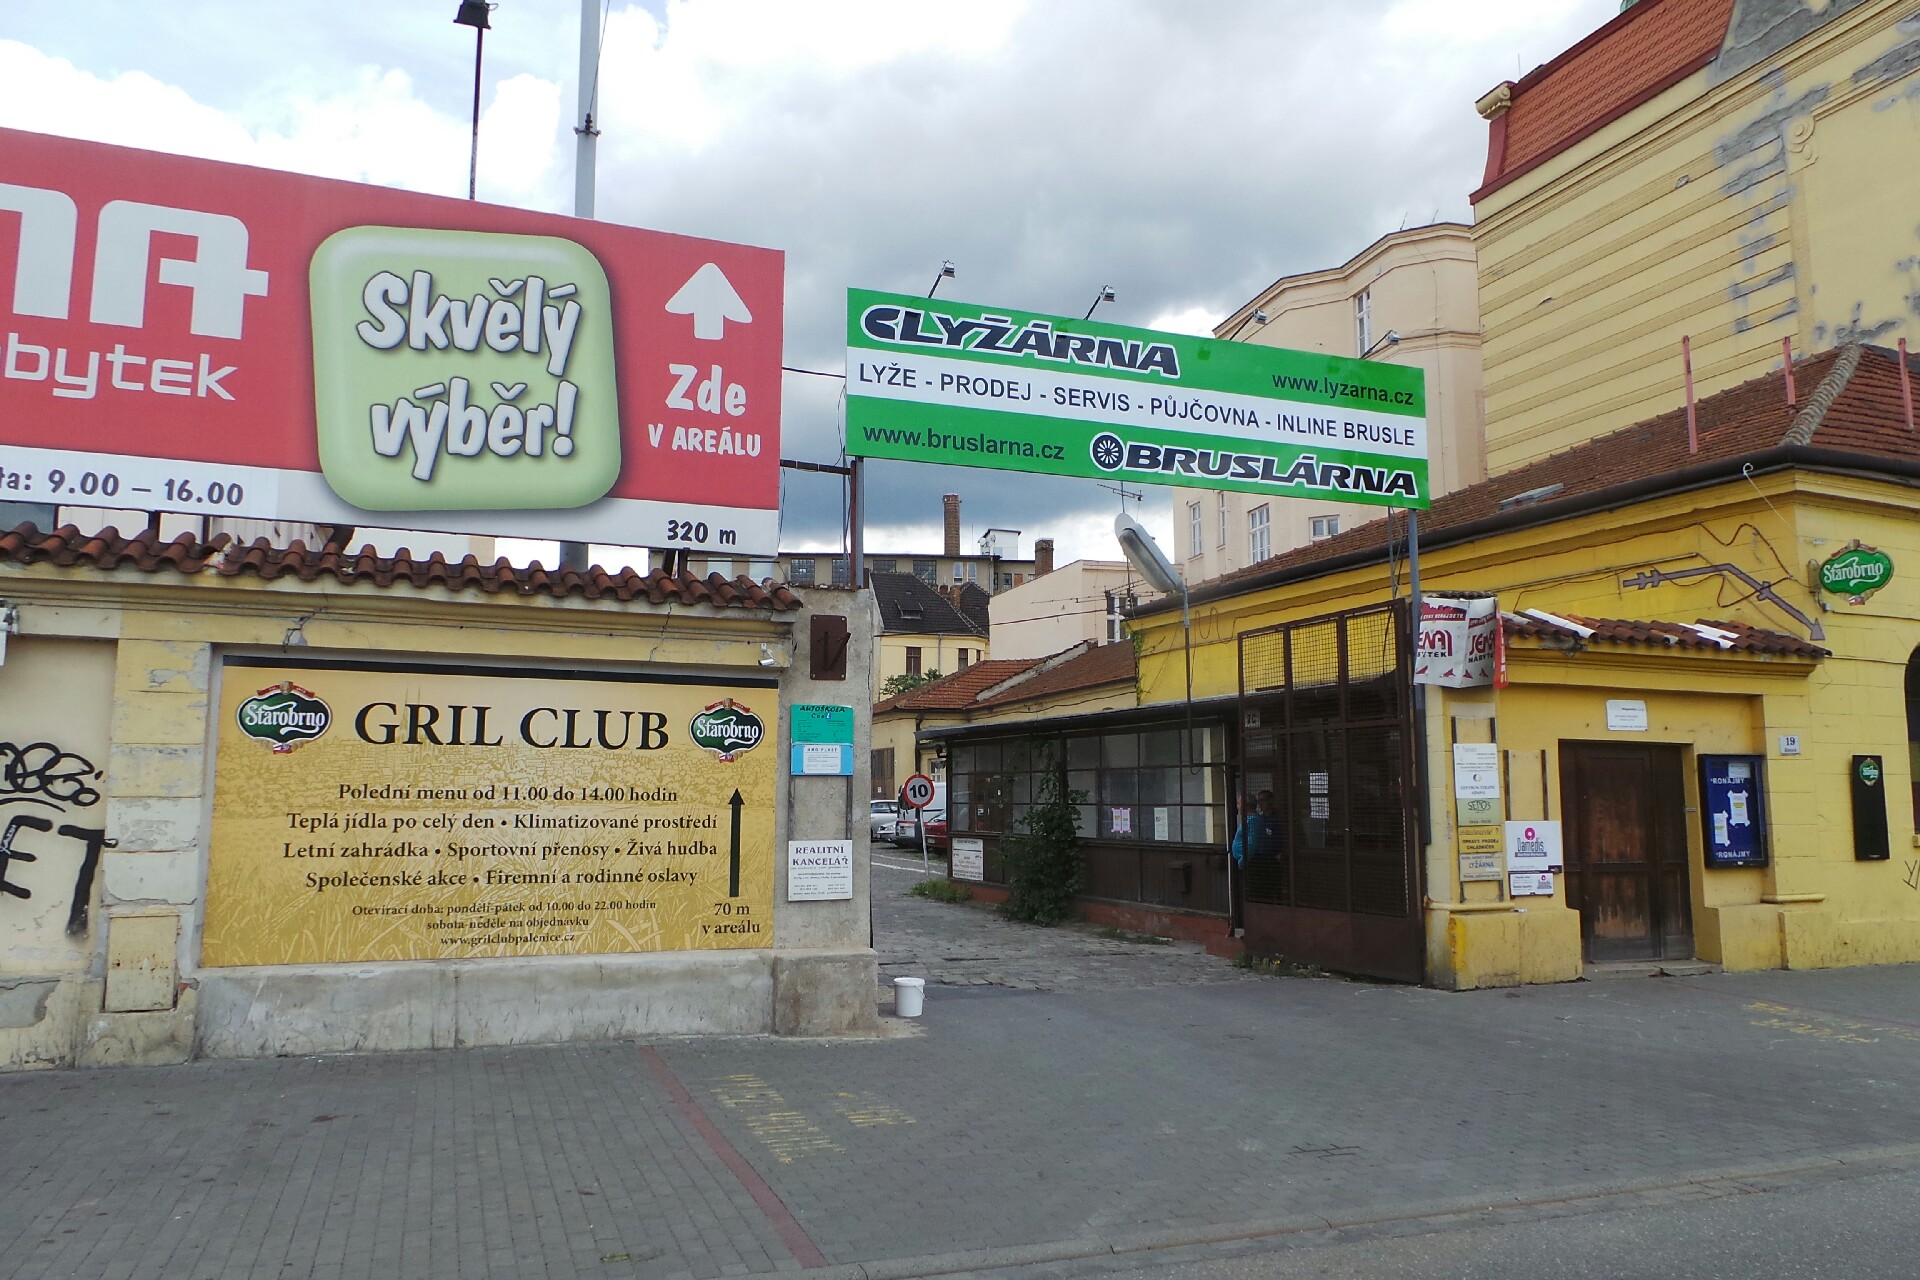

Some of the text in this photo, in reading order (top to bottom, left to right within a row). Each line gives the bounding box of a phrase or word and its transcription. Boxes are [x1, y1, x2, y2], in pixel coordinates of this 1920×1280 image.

[356, 270, 582, 377] Skvělý
[665, 363, 747, 417] Zde
[859, 362, 917, 388] LYŽE
[940, 373, 1031, 401] PRODEJ
[1053, 387, 1130, 412] SERVIS
[1151, 395, 1260, 428] PŮJČOVNA
[1277, 414, 1337, 437] INLINE
[1344, 423, 1415, 446] BRUSLE
[1272, 374, 1414, 406] www.lyzarna.cz
[370, 376, 578, 481] výběr!
[648, 423, 761, 457] V AREÁLU
[863, 425, 1065, 461] www.bruslarna.cz
[1124, 442, 1418, 496] BRUSLÁRNA
[48, 469, 119, 497] 9.00
[164, 478, 244, 506] 16.00
[667, 519, 737, 545] 320 m
[1823, 556, 1884, 587] Starobrno
[245, 702, 326, 735] Starobrno
[355, 702, 669, 750] GRIL CLUB
[696, 716, 759, 745] Starobrno
[1785, 736, 1796, 746] 19
[339, 784, 677, 801] Polední menu od 11.00 do 14.00 hodin
[909, 783, 929, 799] 10
[287, 812, 718, 833] Teplá jídla po celý den Klimatizované prostředí
[283, 838, 718, 861] Letní zahrádka Sportovní přenosy Živá hudba
[795, 844, 844, 854] REALITNÍ
[306, 868, 698, 892] Společenské akce Firemní a rodinné oslavy
[411, 904, 444, 914] doba:
[529, 902, 543, 911] od
[546, 902, 575, 911] 10.00
[578, 901, 591, 911] do
[594, 900, 623, 910] 22.00
[625, 900, 657, 910] hodin
[714, 903, 750, 915] 70 m
[509, 920, 523, 928] na
[526, 917, 589, 929] objednávku
[702, 920, 761, 934] v areálu
